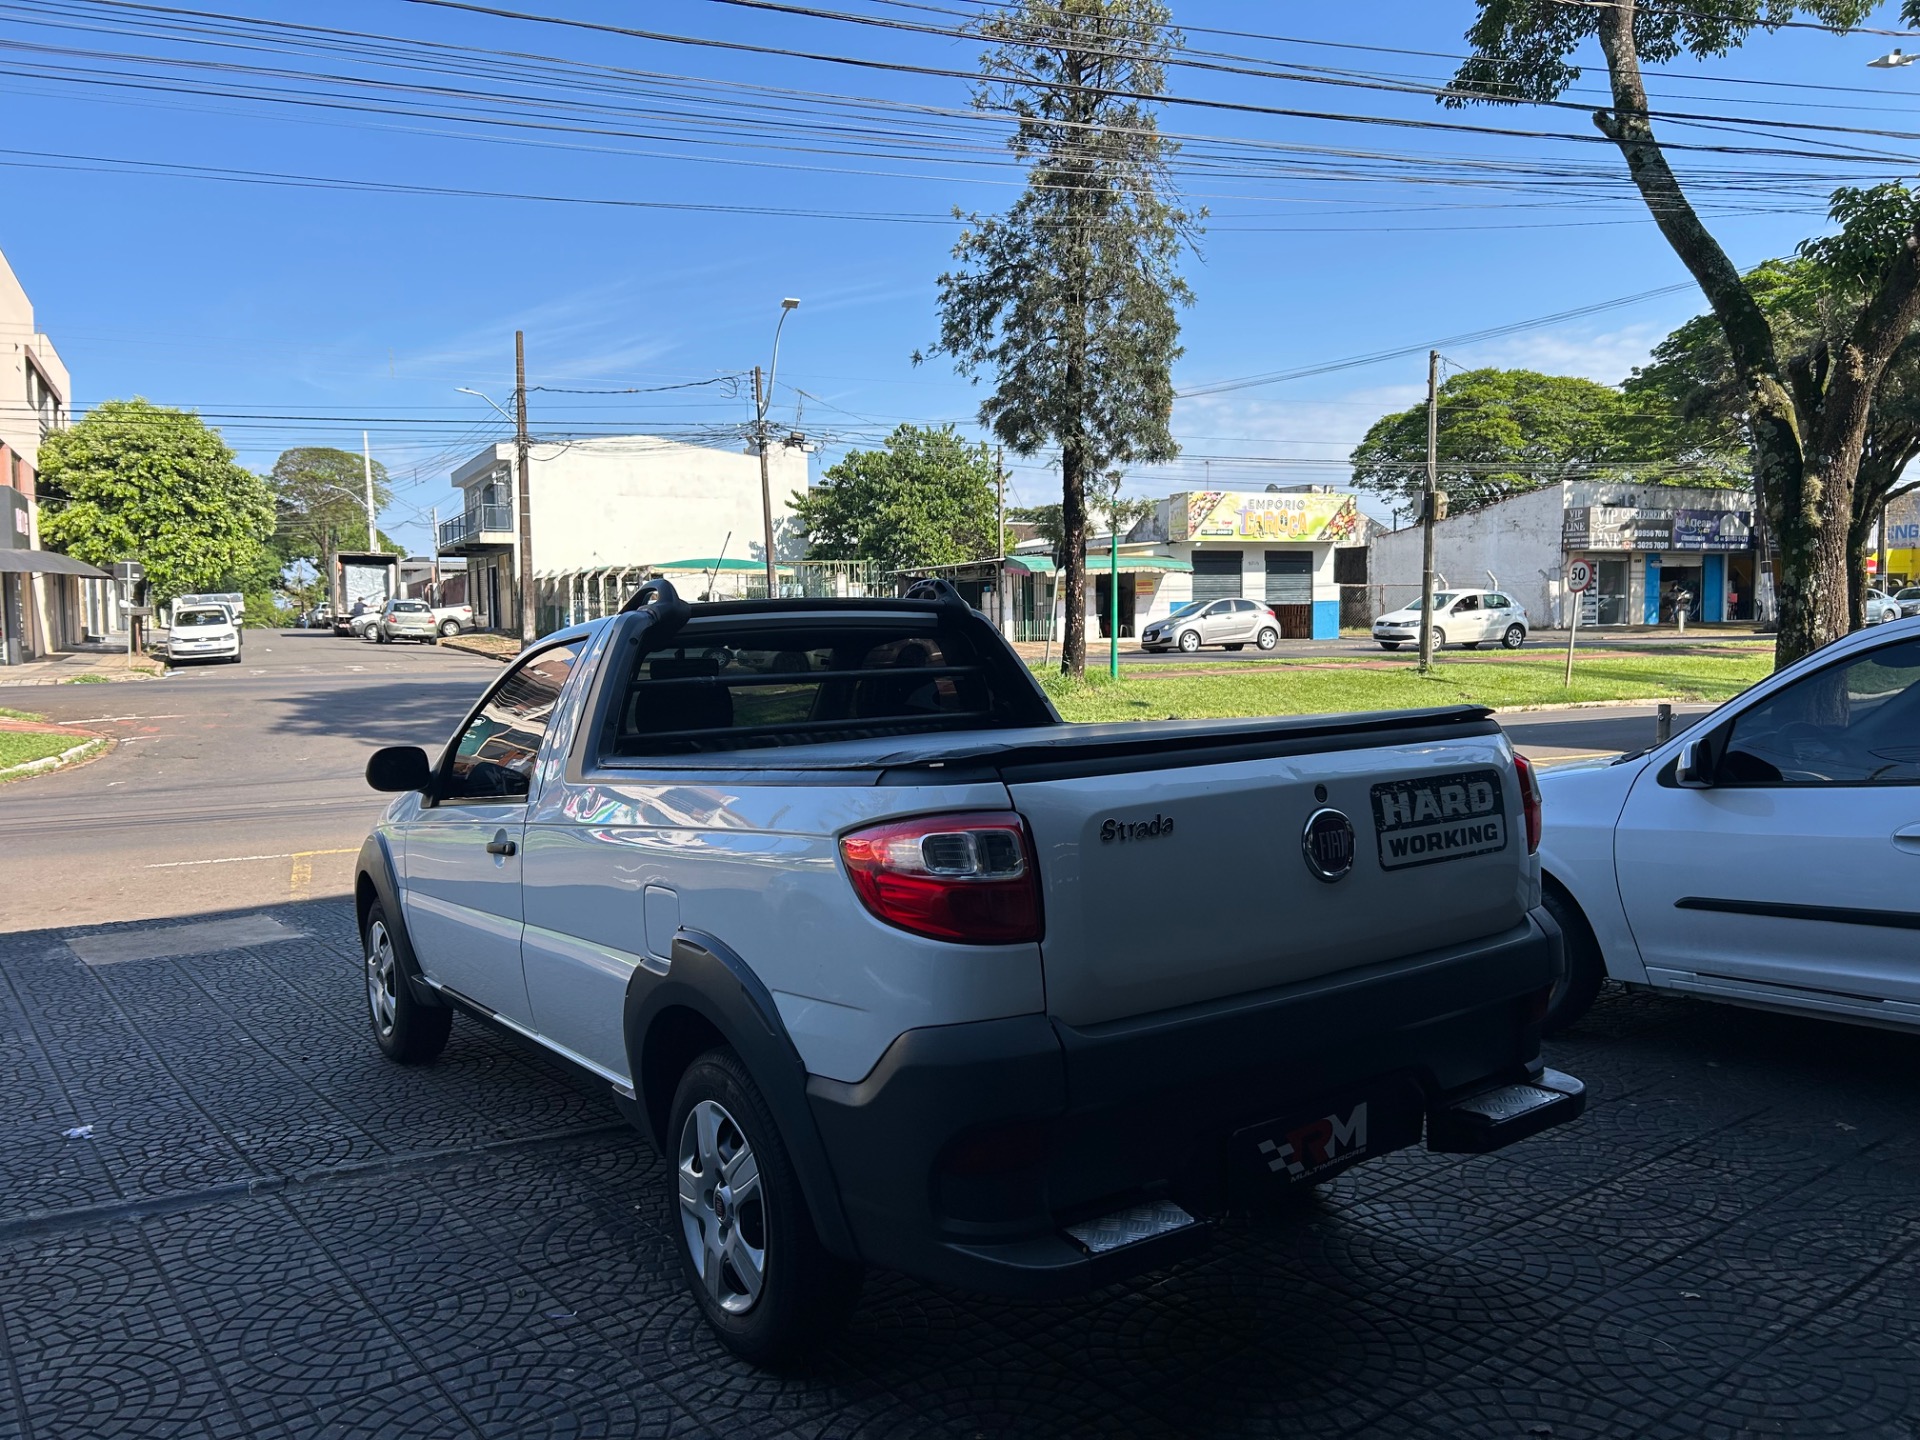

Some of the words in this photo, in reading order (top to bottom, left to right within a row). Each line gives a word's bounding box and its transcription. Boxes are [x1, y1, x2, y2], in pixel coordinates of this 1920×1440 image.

[1248, 498, 1305, 510] EMPÓRIO
[1569, 509, 1583, 518] VIP
[1597, 507, 1618, 524] VIP
[1245, 510, 1308, 538] CARIOCA
[1566, 522, 1585, 531] LINE
[1571, 567, 1586, 581] 50
[1381, 781, 1494, 826] HARD
[1100, 813, 1173, 841] Strada
[1388, 823, 1498, 857] WORKING
[1318, 828, 1347, 861] FIAT
[1289, 1146, 1367, 1184] MULTIMARCAS
